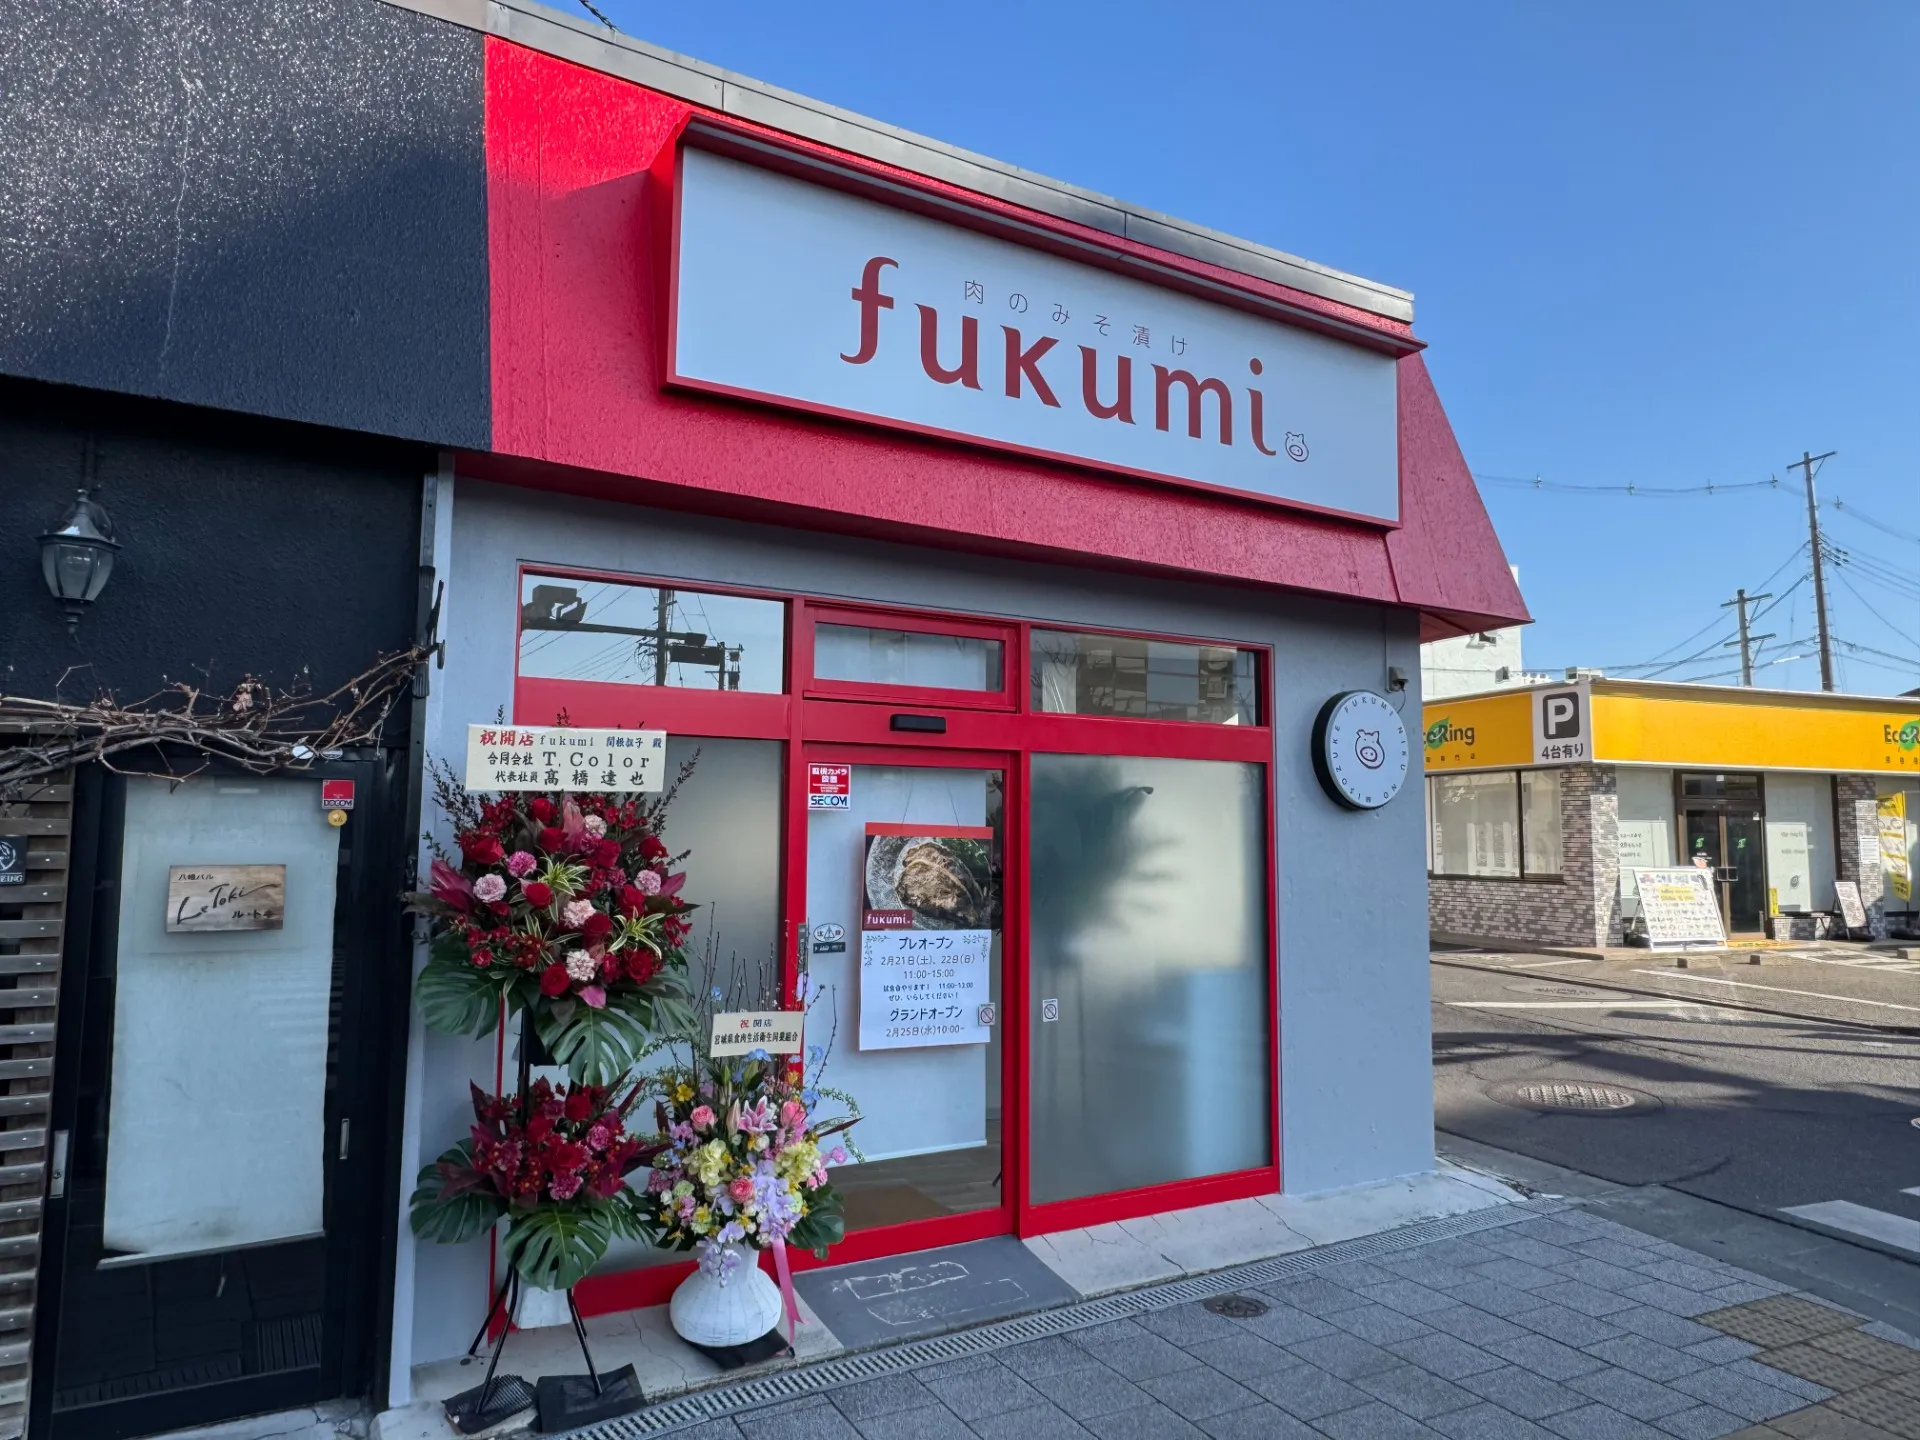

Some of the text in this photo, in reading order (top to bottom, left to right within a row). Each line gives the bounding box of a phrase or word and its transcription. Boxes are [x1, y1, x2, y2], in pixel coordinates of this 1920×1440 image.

[963, 277, 1190, 357] 肉のみそ漬け
[840, 254, 1277, 457] fukumi
[1344, 696, 1394, 717] FUKUMI
[1546, 697, 1574, 736] P
[479, 729, 535, 747] 祝開店
[540, 735, 594, 748] fukumi
[487, 751, 534, 767] 合同会社
[1541, 743, 1584, 760] 4台有り
[495, 771, 539, 784] 代表社員
[810, 795, 848, 807] SECOM
[866, 912, 906, 926] fukumi
[898, 936, 954, 951] プレオープン
[889, 1005, 964, 1022] グランドオープン
